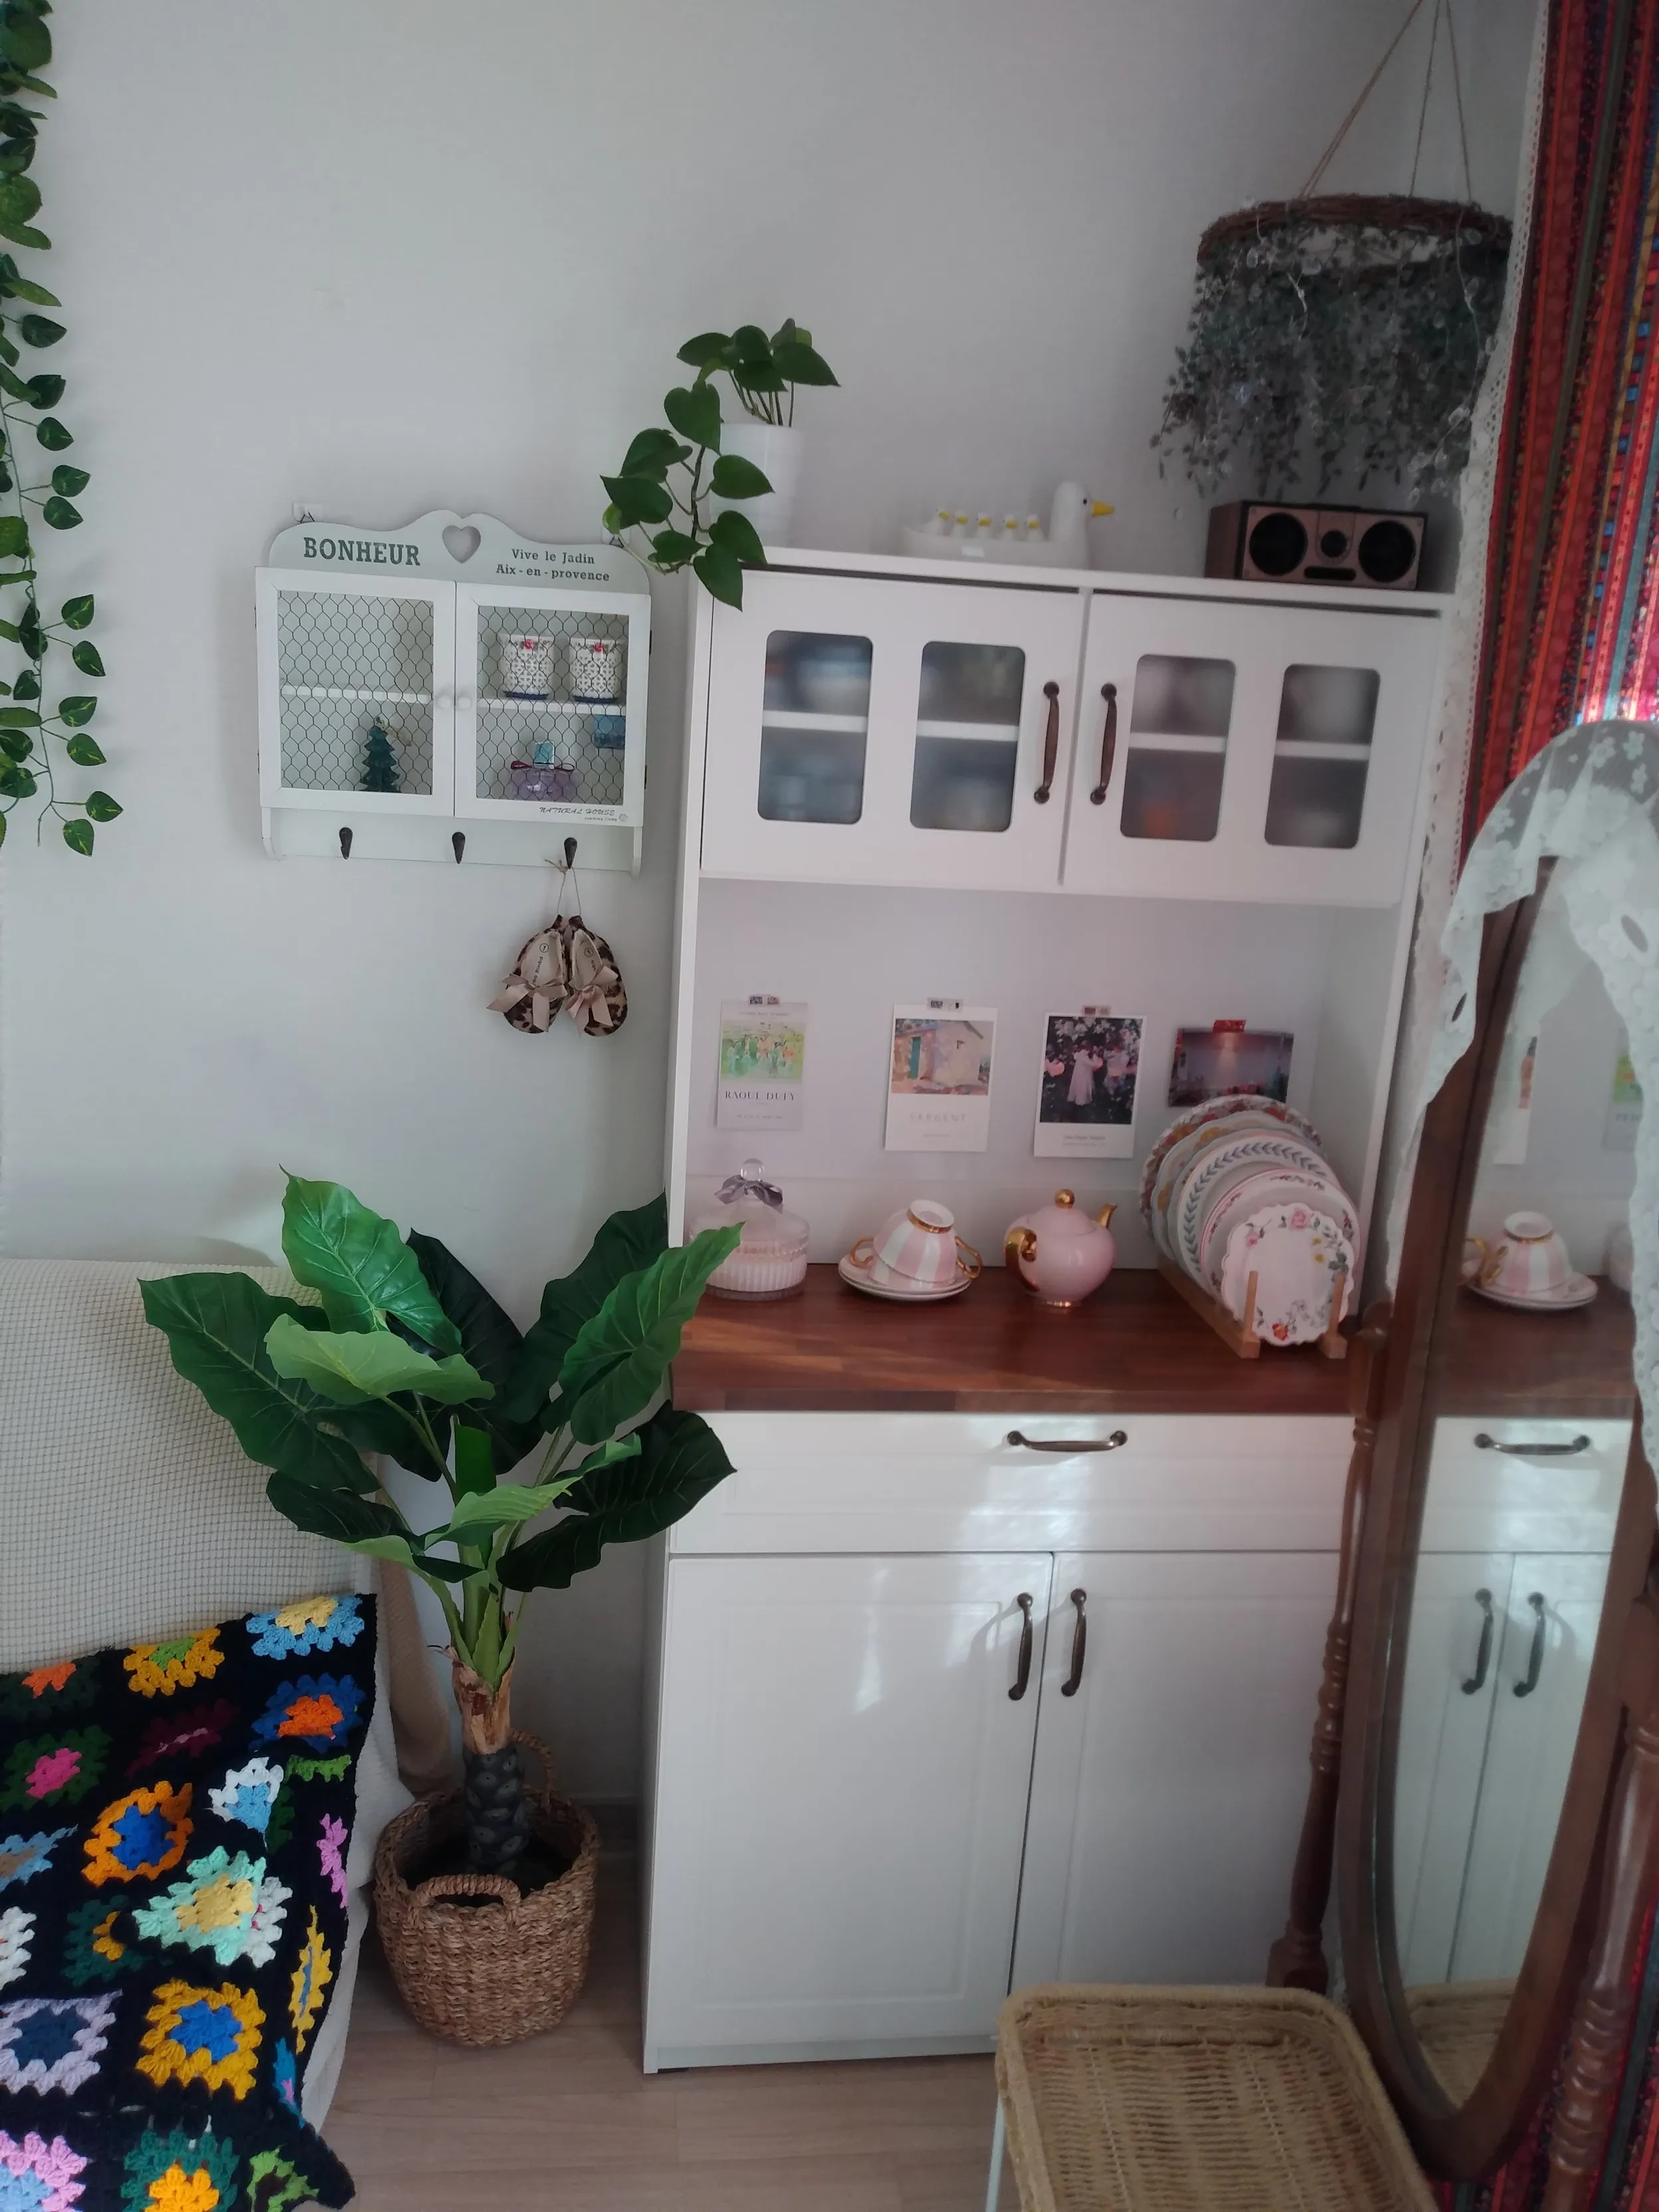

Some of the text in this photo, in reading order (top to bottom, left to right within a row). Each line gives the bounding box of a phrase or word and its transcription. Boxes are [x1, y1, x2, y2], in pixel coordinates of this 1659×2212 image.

[303, 537, 421, 567] BONHEUR
[511, 548, 595, 565] Vive le Jadin
